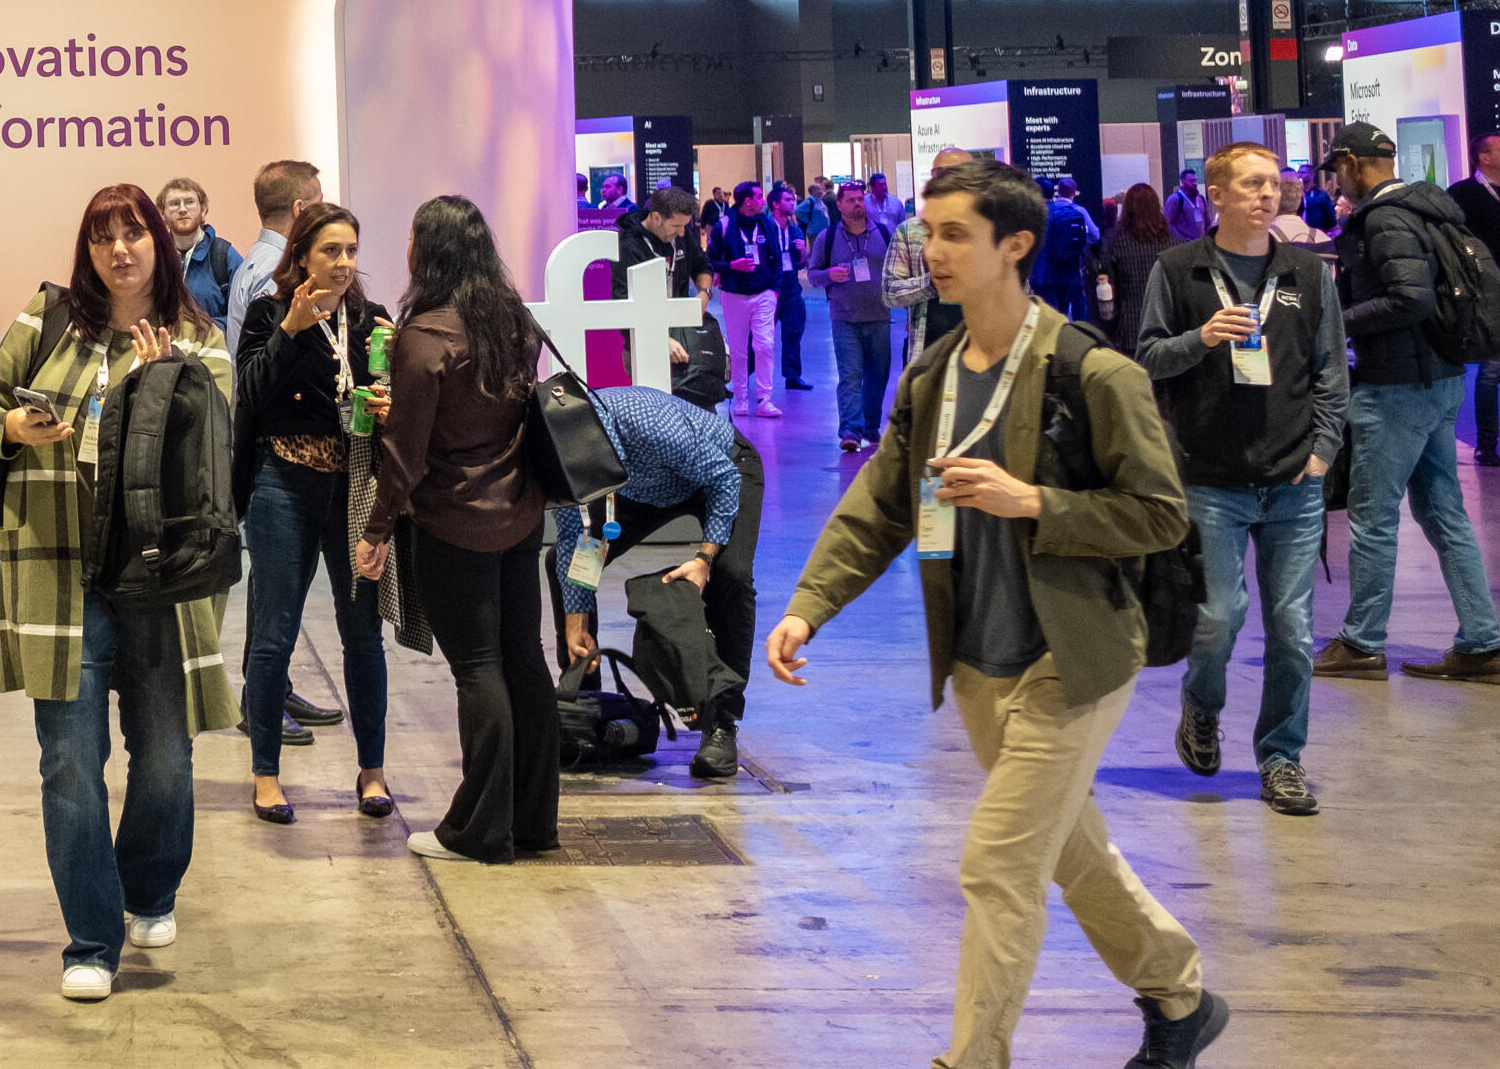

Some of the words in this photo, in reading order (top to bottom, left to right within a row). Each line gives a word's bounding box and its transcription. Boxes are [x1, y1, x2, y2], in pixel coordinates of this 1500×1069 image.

[1347, 39, 1358, 52] Data
[1200, 46, 1242, 67] Zon
[1024, 86, 1082, 96] Infrastructure
[1181, 90, 1226, 98] Infrastructure
[1350, 78, 1381, 100] Microsoft
[915, 96, 941, 107] Infrastructure
[644, 120, 652, 129] AI
[1025, 116, 1042, 125] Meet
[1043, 115, 1058, 124] with
[917, 125, 933, 137] Azure
[934, 124, 940, 136] AI
[1025, 124, 1051, 133] experts
